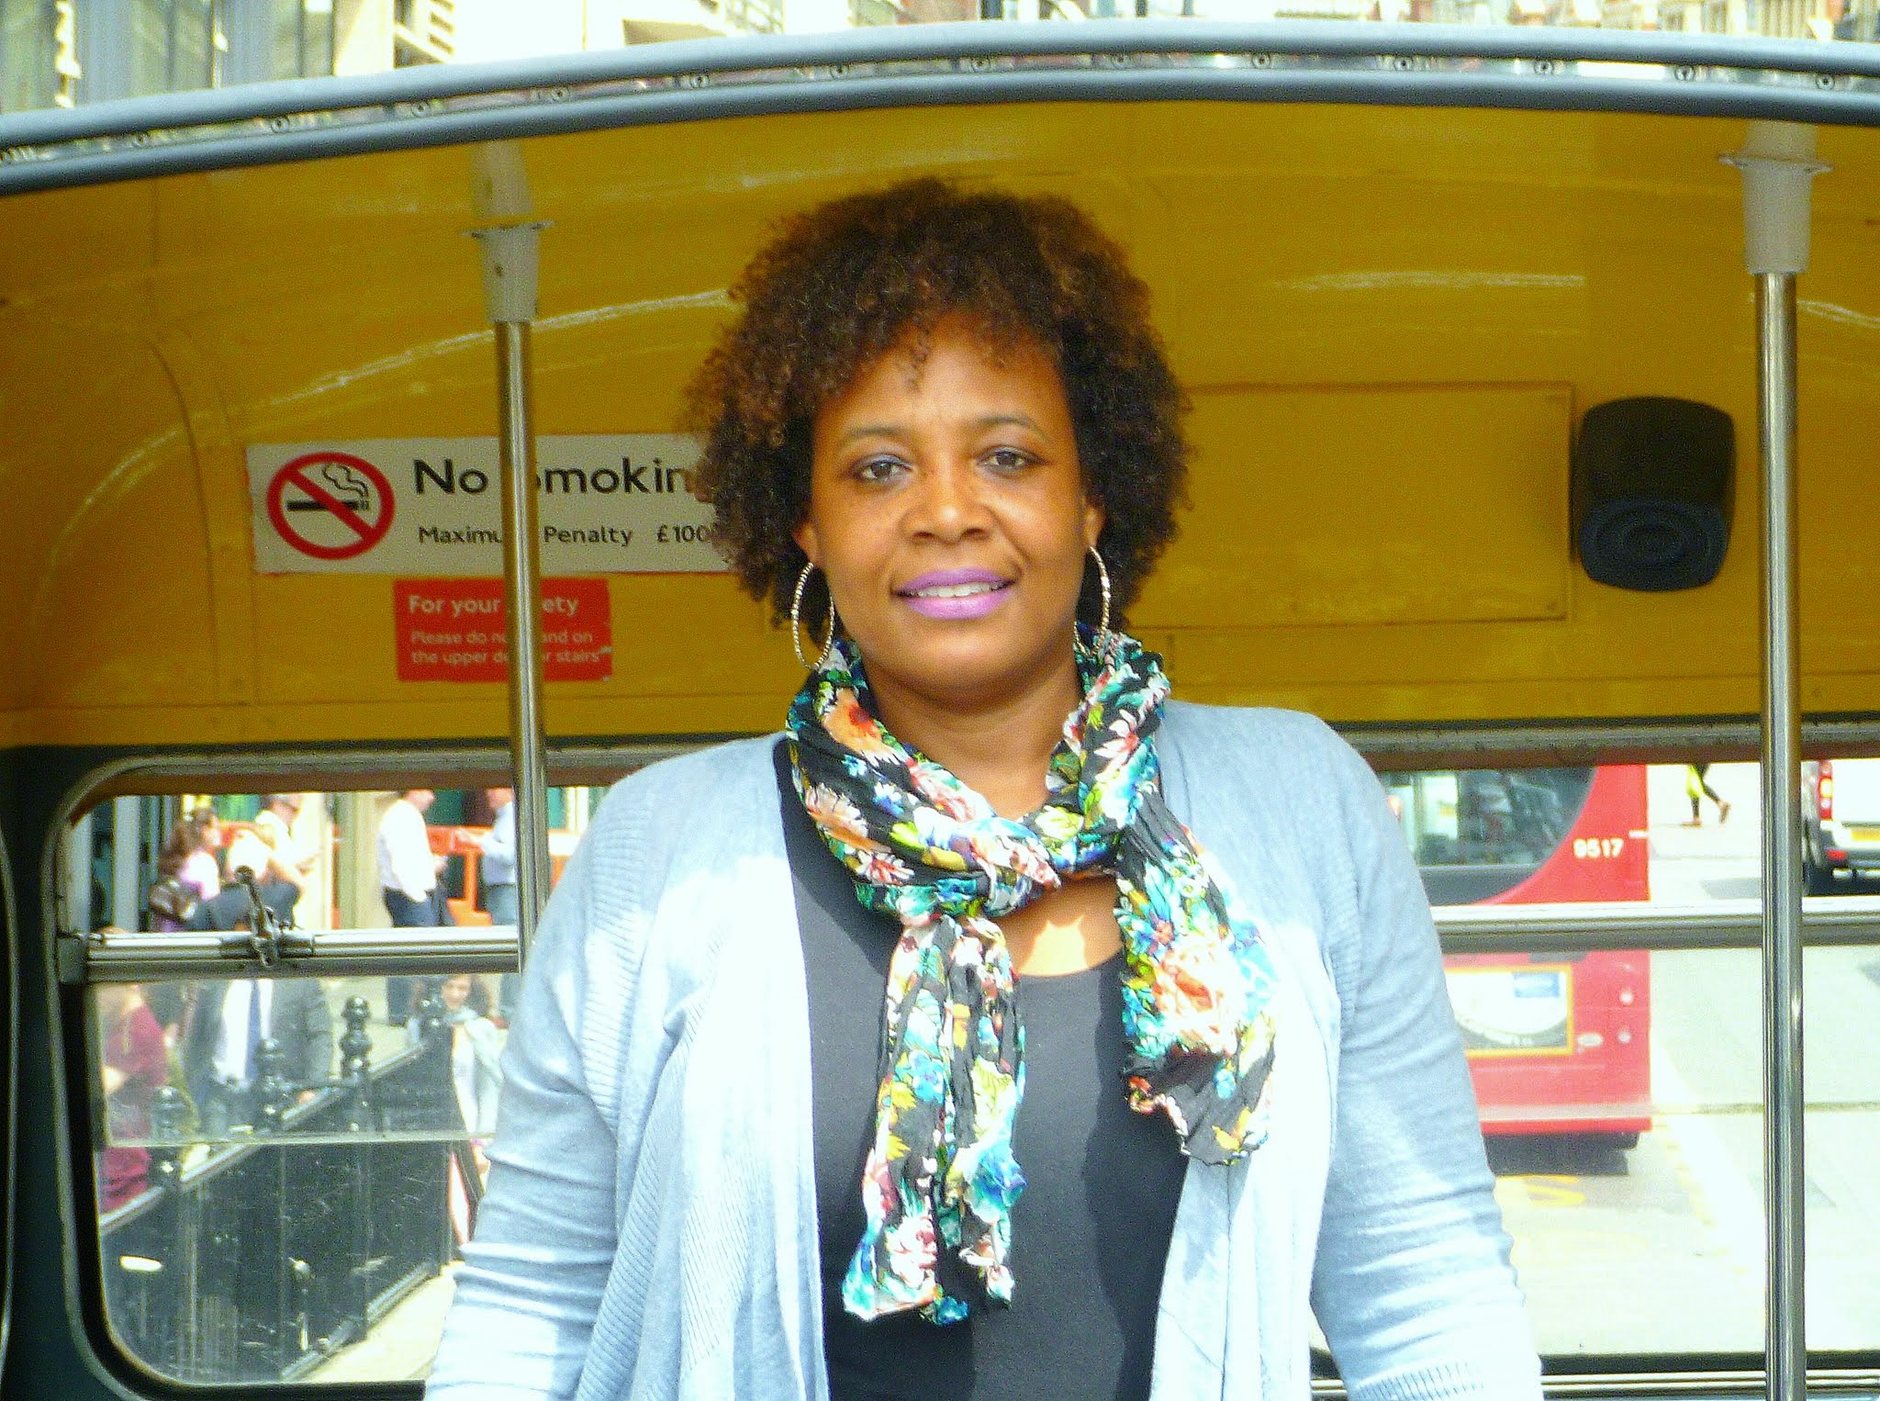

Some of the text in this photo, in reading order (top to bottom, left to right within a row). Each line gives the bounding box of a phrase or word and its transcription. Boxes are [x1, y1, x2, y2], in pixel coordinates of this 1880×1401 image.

[413, 456, 688, 495] No mokin
[418, 523, 713, 547] Maximu Penalty £100
[408, 594, 579, 618] For your ety
[410, 632, 461, 645] Please
[467, 631, 487, 645] do
[573, 632, 593, 644] on
[411, 651, 438, 663] the
[442, 652, 488, 666] upper
